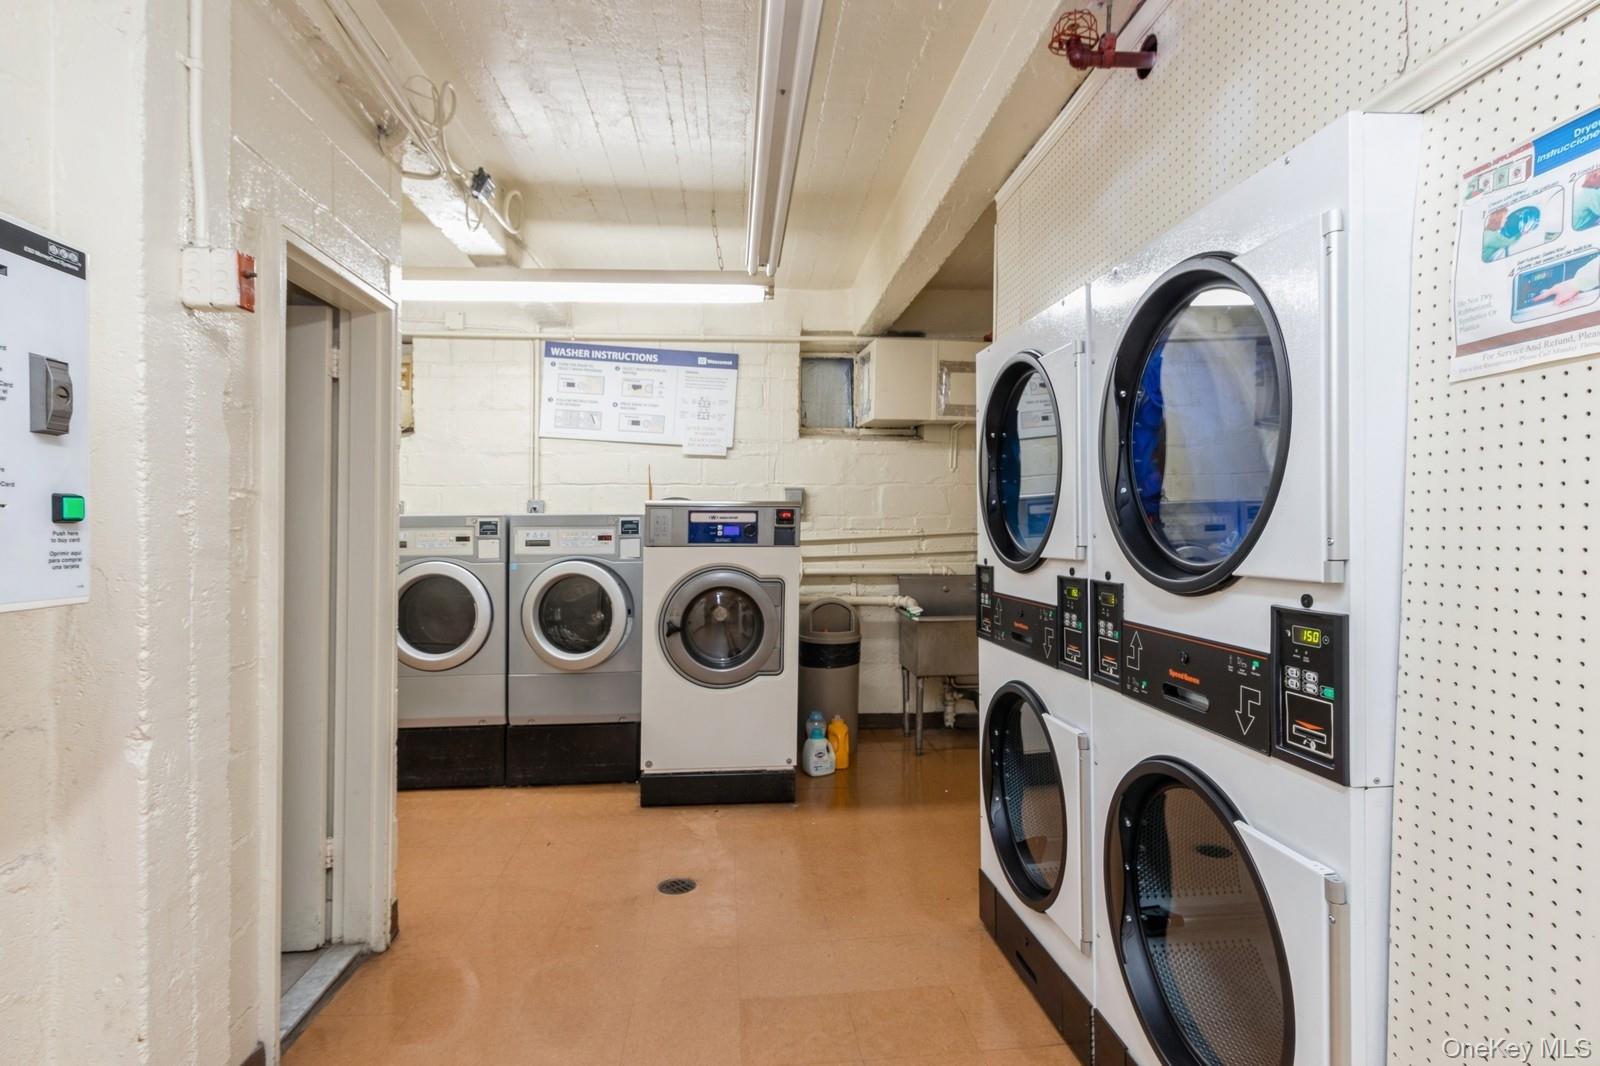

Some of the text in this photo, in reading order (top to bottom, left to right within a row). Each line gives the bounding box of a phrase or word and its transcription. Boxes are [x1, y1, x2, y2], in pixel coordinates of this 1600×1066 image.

[1525, 342, 1541, 353] And
[551, 347, 658, 362] WASHER INSTRUCTIONS
[1303, 630, 1319, 643] 150
[1168, 668, 1184, 681] Speed
